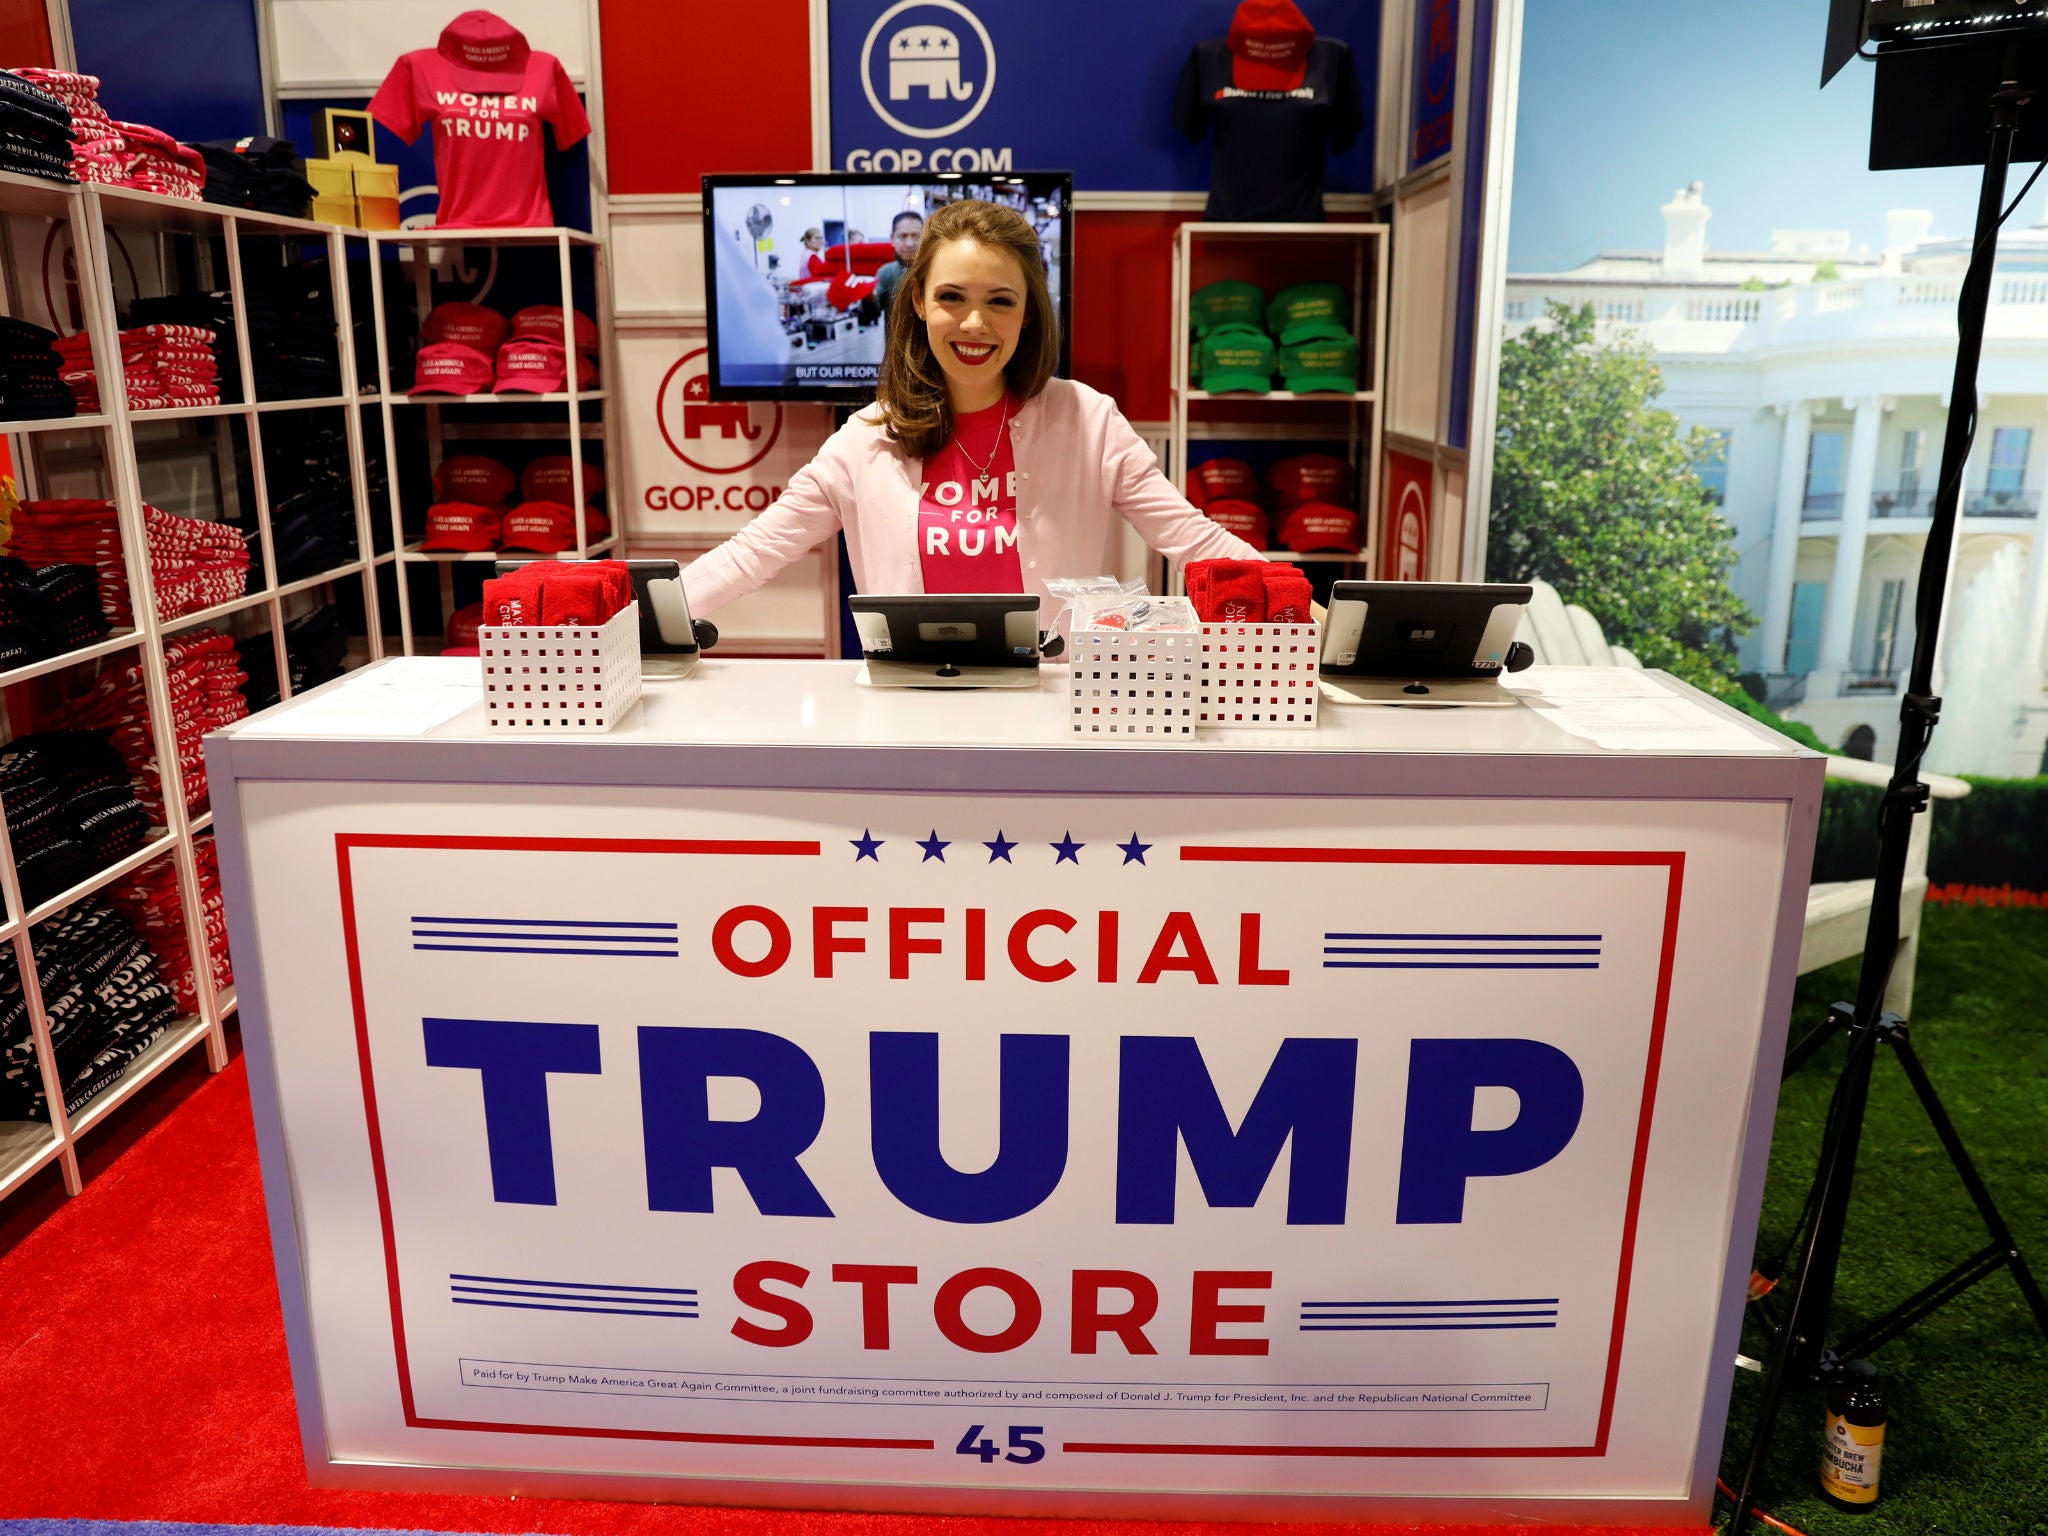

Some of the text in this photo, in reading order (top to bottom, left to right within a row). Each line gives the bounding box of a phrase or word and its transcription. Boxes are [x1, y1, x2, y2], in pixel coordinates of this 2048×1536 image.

[437, 91, 537, 112] WOMEN
[469, 108, 500, 119] FOR
[441, 118, 529, 141] TRUMP
[846, 147, 1012, 172] GOP.COM
[796, 366, 881, 378] BUT OUR PEOPL
[920, 470, 1016, 506] OME
[951, 506, 998, 523] FOR
[926, 525, 1018, 557] RUM
[511, 600, 522, 625] MAK
[712, 905, 1290, 986] OFFICIAL
[422, 1018, 1584, 1225] TRUMP
[731, 1260, 1272, 1356] STORE
[473, 1368, 496, 1379] Paid
[499, 1370, 514, 1380] for
[517, 1372, 530, 1383] by
[533, 1373, 566, 1385] Trump
[569, 1375, 598, 1385] Make
[601, 1377, 645, 1388] America
[648, 1379, 678, 1390] Great
[681, 1381, 712, 1393] Again
[715, 1382, 779, 1395] Committee,
[791, 1385, 816, 1397] joint
[819, 1385, 879, 1398] fundraising
[882, 1387, 941, 1398] committee
[944, 1389, 1002, 1399] authorized
[1006, 1390, 1019, 1401] by
[1022, 1391, 1043, 1400] and
[1046, 1391, 1104, 1402] composed
[1107, 1392, 1118, 1401] of
[1121, 1391, 1161, 1401] Donald
[1164, 1392, 1173, 1401] J.
[1176, 1392, 1211, 1403] Trump
[1214, 1392, 1231, 1402] for
[1233, 1393, 1287, 1404] President,
[1291, 1394, 1311, 1402] Inc.
[1314, 1394, 1335, 1402] and
[1338, 1393, 1356, 1402] the
[1358, 1393, 1419, 1404] Republican
[1422, 1393, 1468, 1402] National
[1471, 1393, 1532, 1402] Committee
[956, 1425, 1045, 1464] 45
[1843, 1450, 1865, 1462] BREW
